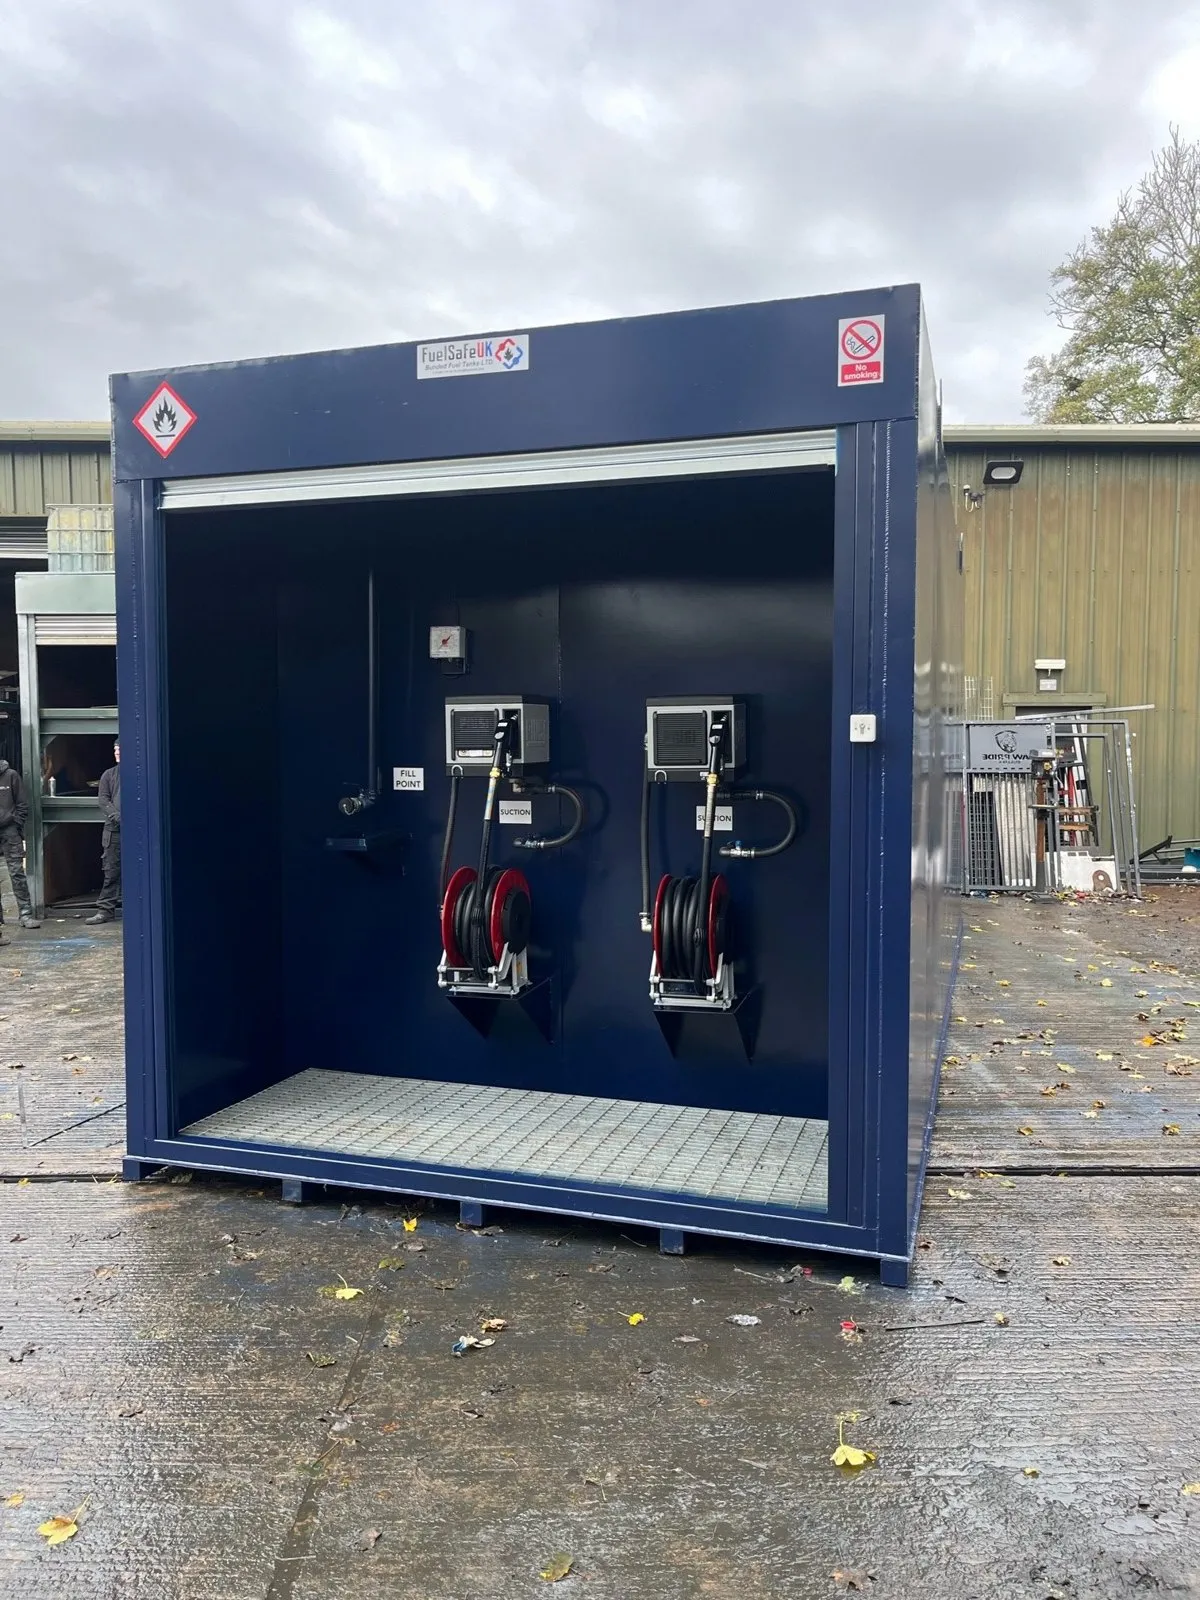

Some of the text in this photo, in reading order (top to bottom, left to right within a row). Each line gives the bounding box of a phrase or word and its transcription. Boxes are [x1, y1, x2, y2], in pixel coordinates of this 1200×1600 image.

[422, 341, 492, 363] FuelSafeUK
[448, 360, 461, 369] Fuel
[855, 364, 867, 372] No
[844, 371, 878, 381] smoking
[400, 770, 416, 778] FILL
[396, 780, 421, 788] POINT
[697, 814, 732, 822] SUION
